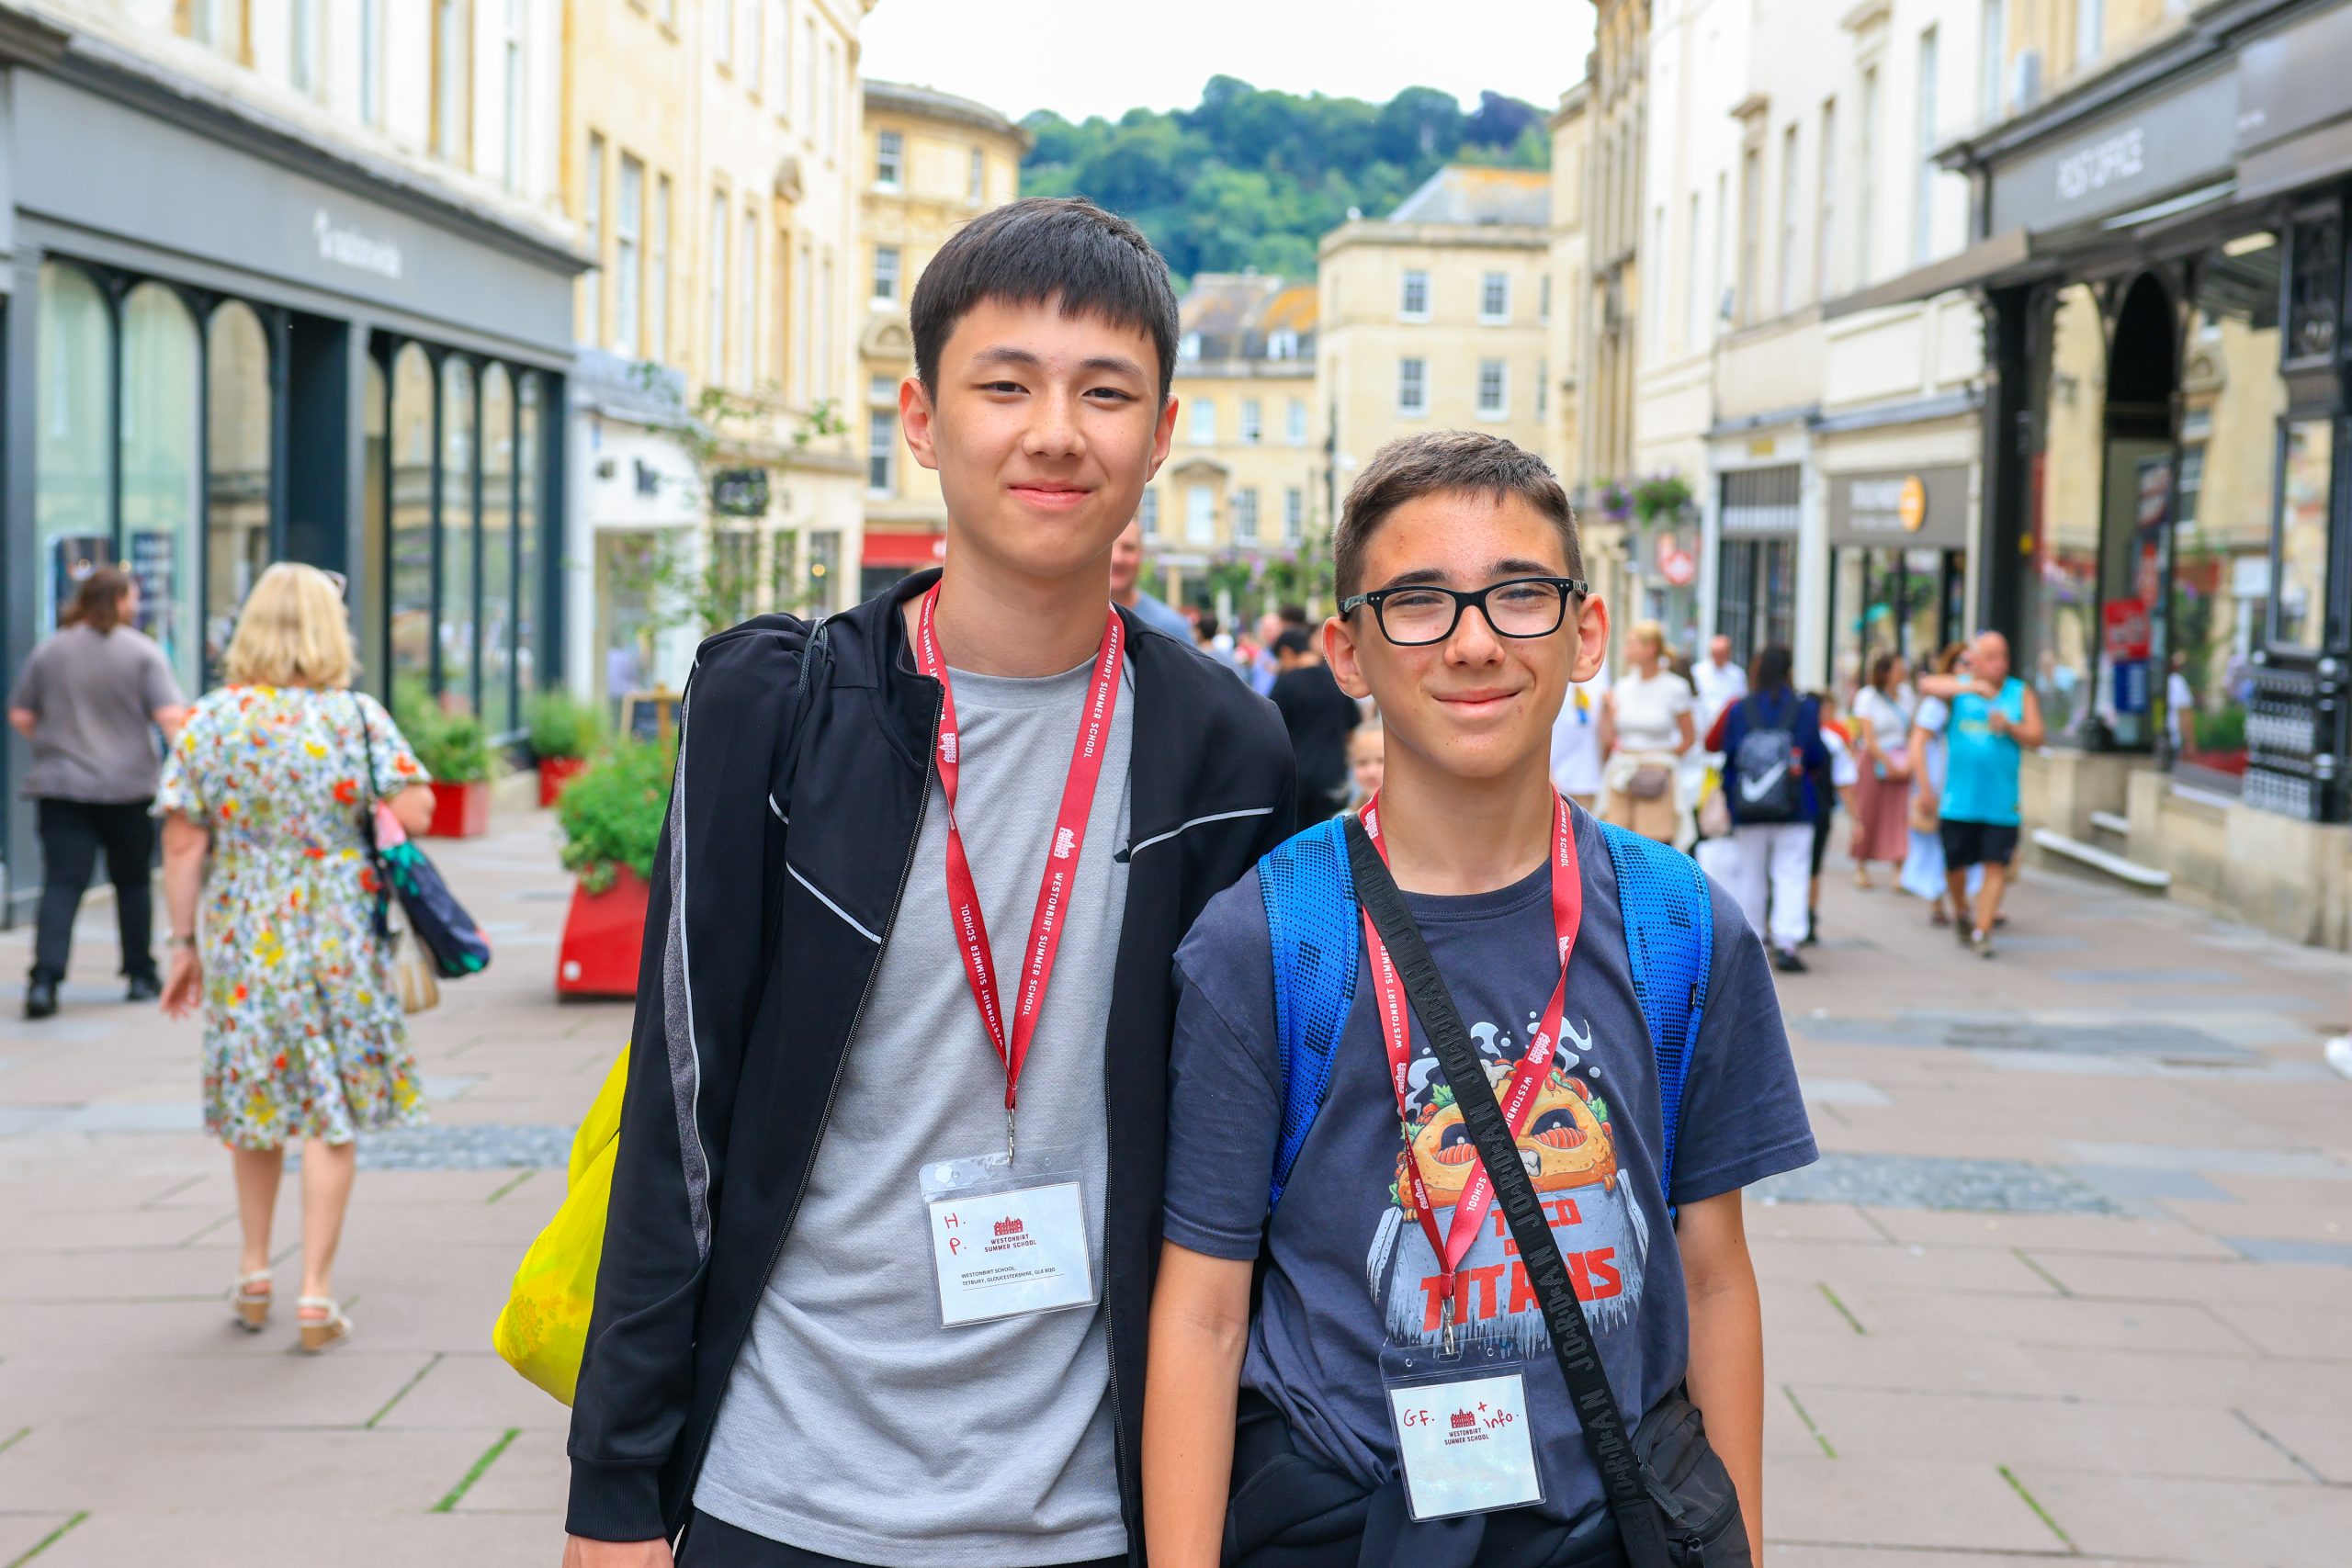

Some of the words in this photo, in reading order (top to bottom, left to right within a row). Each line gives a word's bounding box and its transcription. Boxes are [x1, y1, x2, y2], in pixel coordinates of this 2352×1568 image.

[923, 627, 935, 665] SUMMER
[1102, 625, 1118, 680] WESTONBIRT
[1092, 682, 1109, 719] SUMMER
[1083, 722, 1100, 758] SCHOOL
[1559, 837, 1569, 867] SCHOOL
[1042, 872, 1064, 932] WESTONBIRT
[960, 903, 977, 942] SCHOOL
[970, 945, 988, 986] SUMMER
[1032, 935, 1048, 976] SUMMER
[1023, 979, 1038, 1016] SCHOOL
[982, 988, 1003, 1047] WESTONBIRT
[1386, 987, 1403, 1049] WESTONBIRT
[1465, 1176, 1487, 1213] SCHOOL
[984, 1243, 1012, 1253] SUMMER
[1012, 1238, 1037, 1249] SCHOOL
[989, 1233, 1029, 1245] WESTONBIRT
[961, 1269, 994, 1279] WESTONBIRT
[962, 1278, 987, 1287] TETBURY,
[1420, 1247, 1623, 1333] TITANS
[1444, 1437, 1466, 1446] SUMMER
[1466, 1432, 1490, 1444] SCHOOL
[1448, 1427, 1482, 1438] WESTONBIRT
